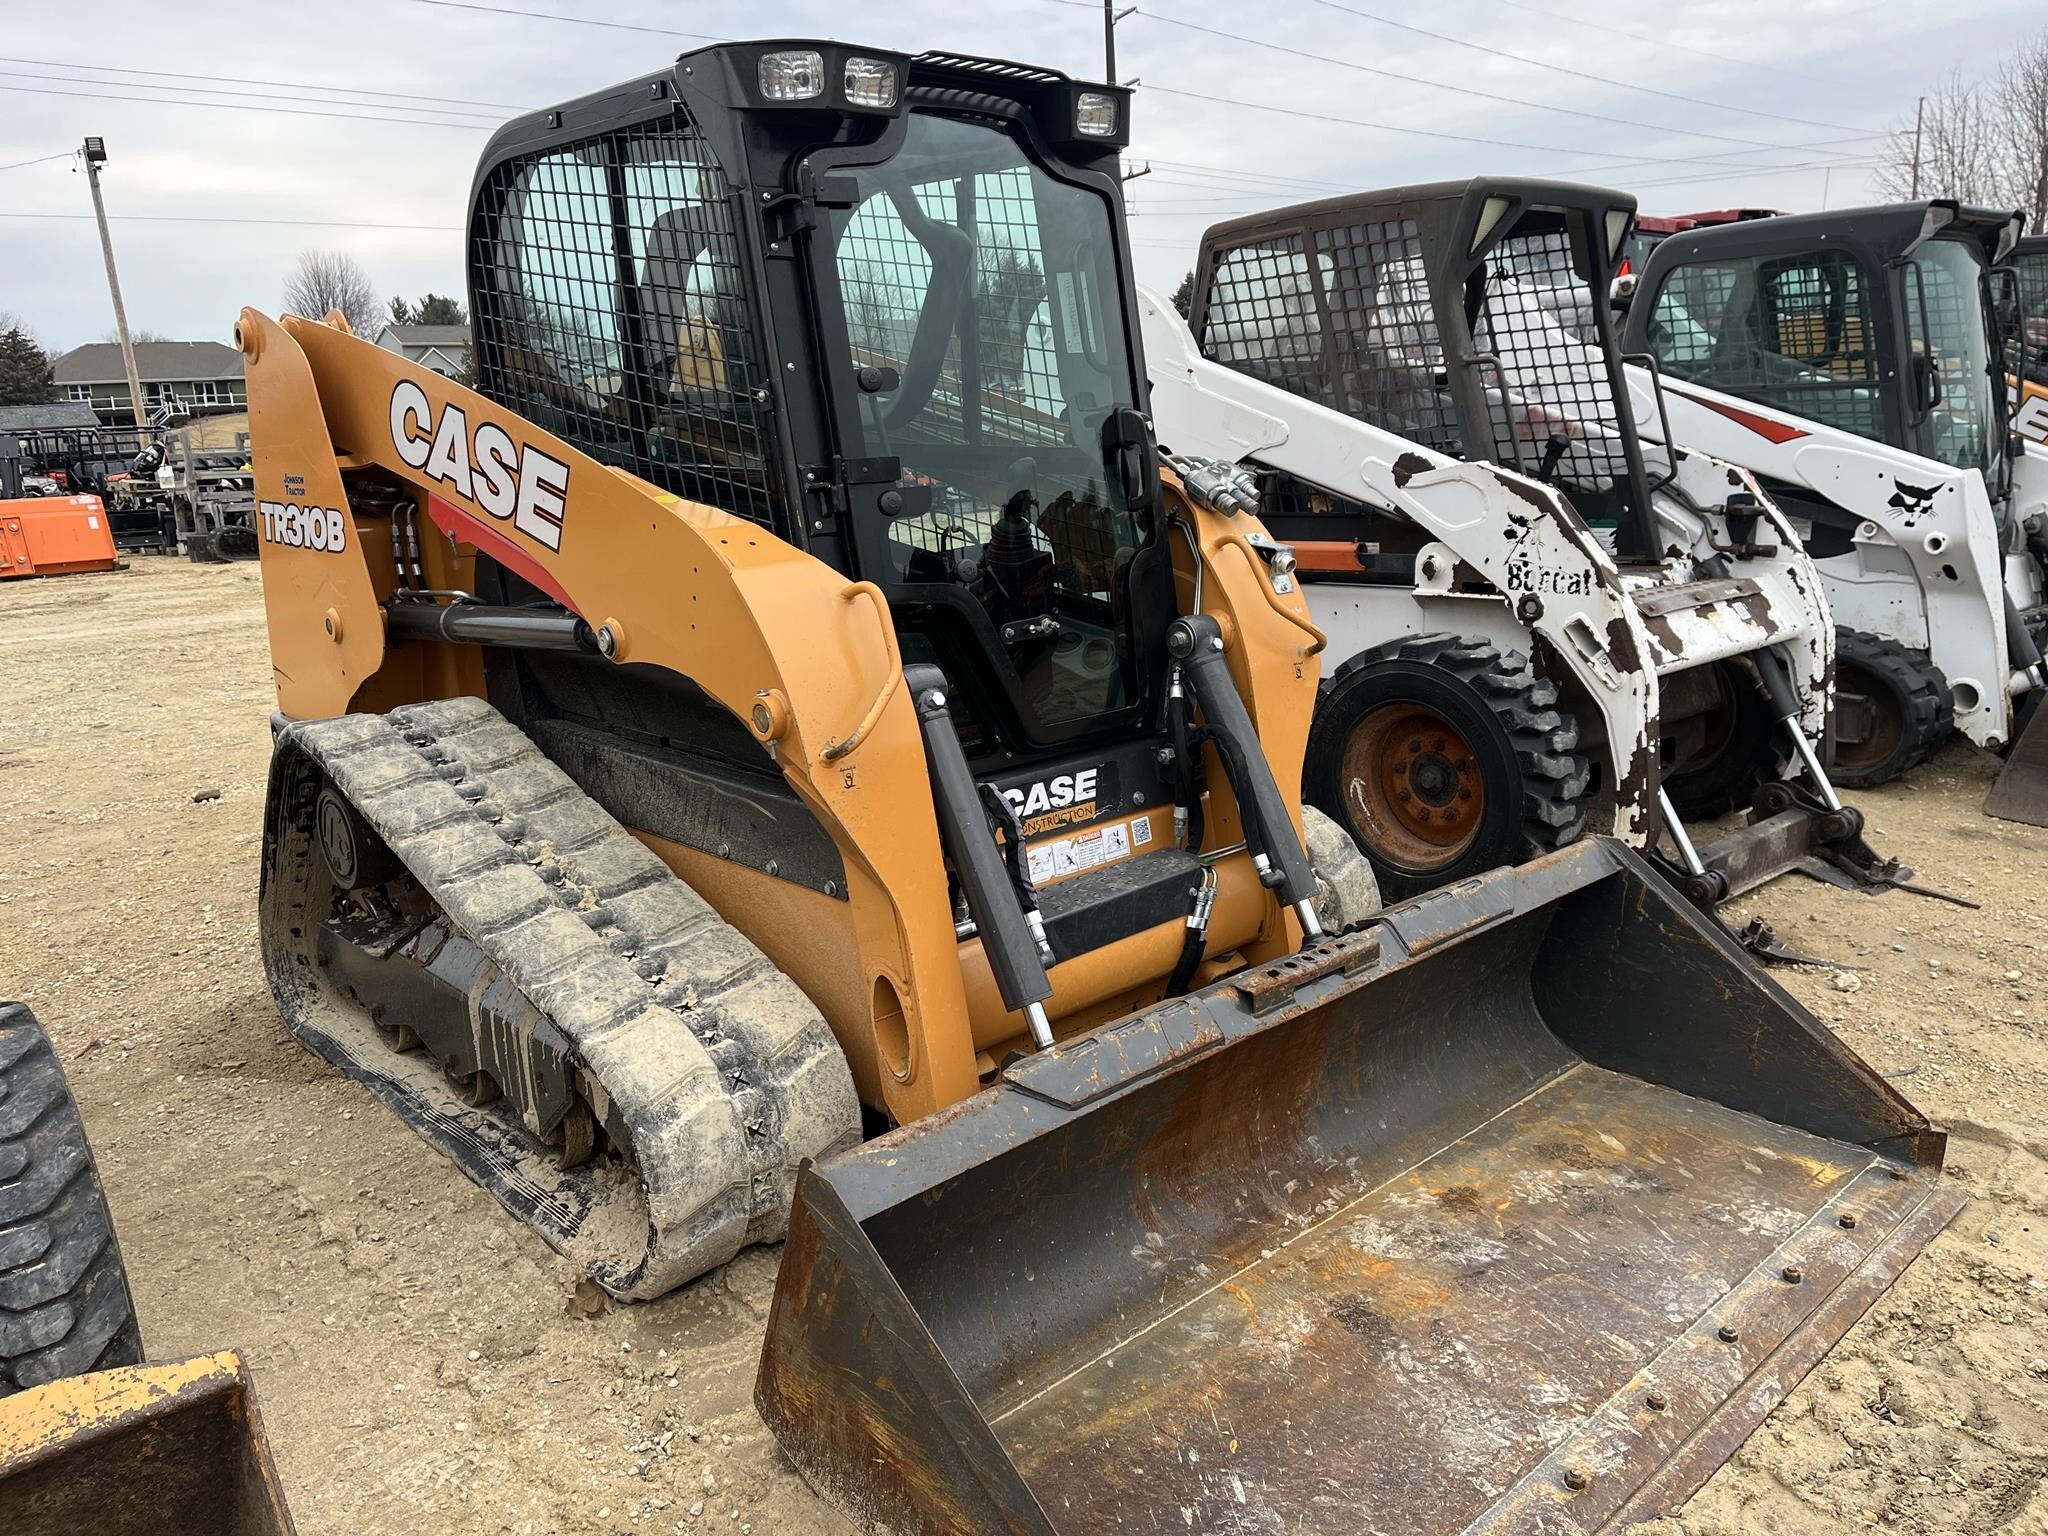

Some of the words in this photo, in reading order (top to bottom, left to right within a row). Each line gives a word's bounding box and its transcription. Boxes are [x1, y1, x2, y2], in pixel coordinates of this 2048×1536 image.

[390, 379, 570, 554] CASE
[259, 500, 346, 553] TR310B
[1002, 768, 1097, 818] CASE
[1022, 805, 1094, 834] ONSTRUCTION
